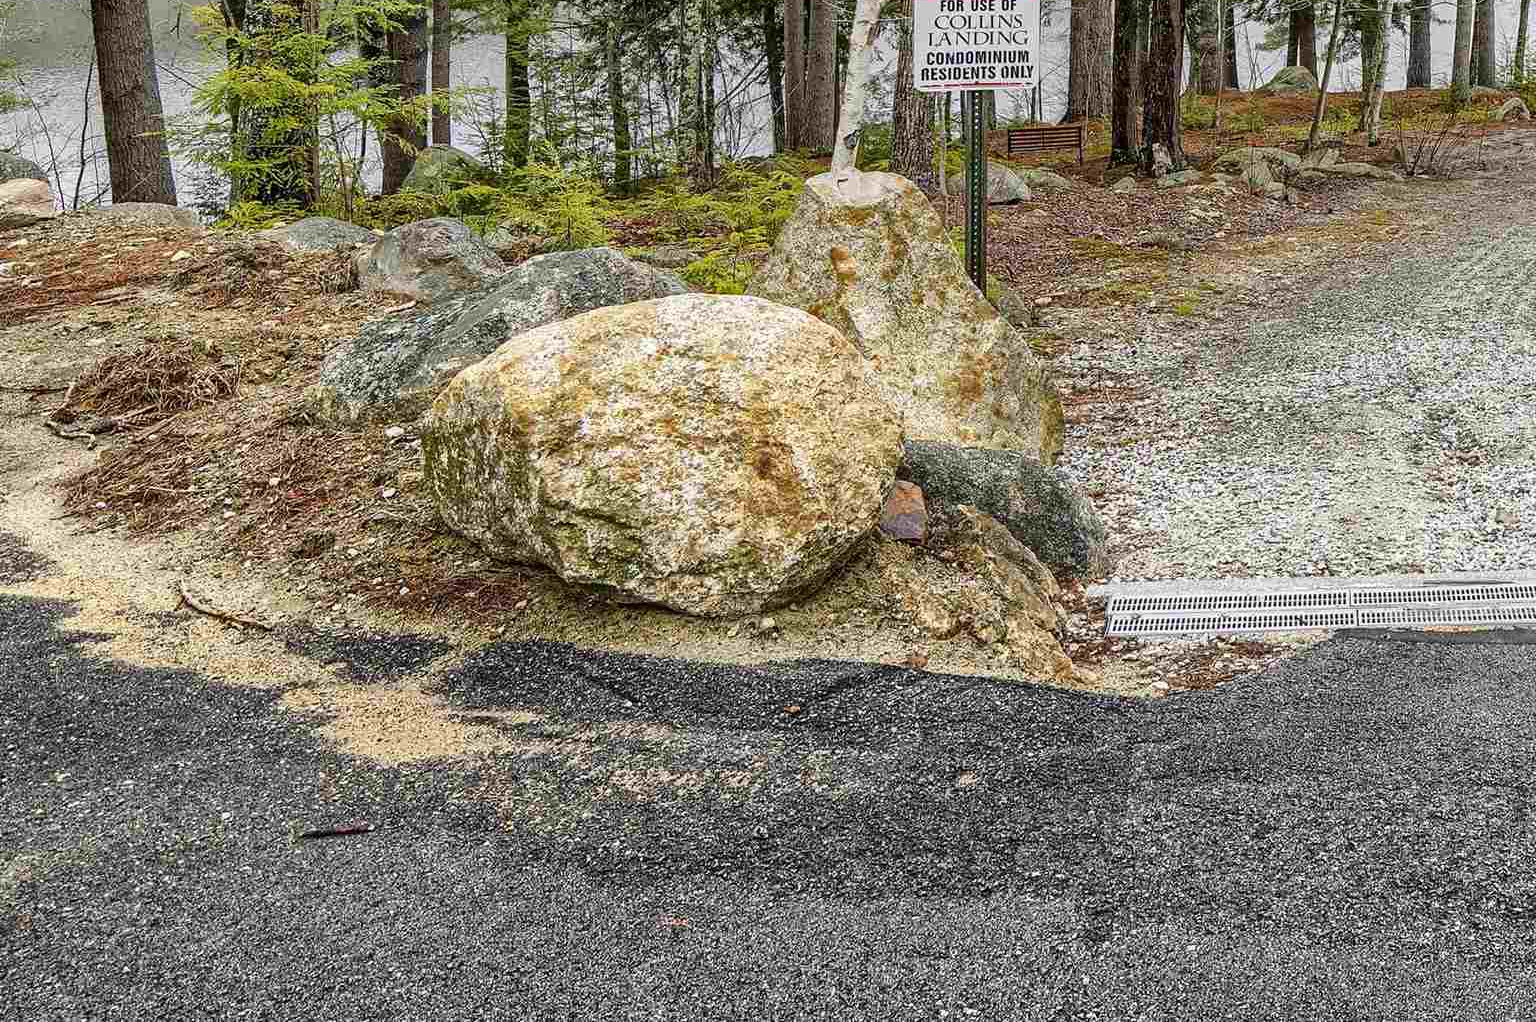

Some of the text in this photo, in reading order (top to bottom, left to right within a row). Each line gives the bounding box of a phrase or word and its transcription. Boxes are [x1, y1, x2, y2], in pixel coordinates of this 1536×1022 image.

[940, 0, 1017, 12] FOR USE OF
[935, 14, 1023, 30] COLLINS
[928, 30, 1029, 47] LANDING
[927, 50, 1029, 65] CONDOMINIUM
[921, 65, 1034, 81] RESIDENTS ONLY
